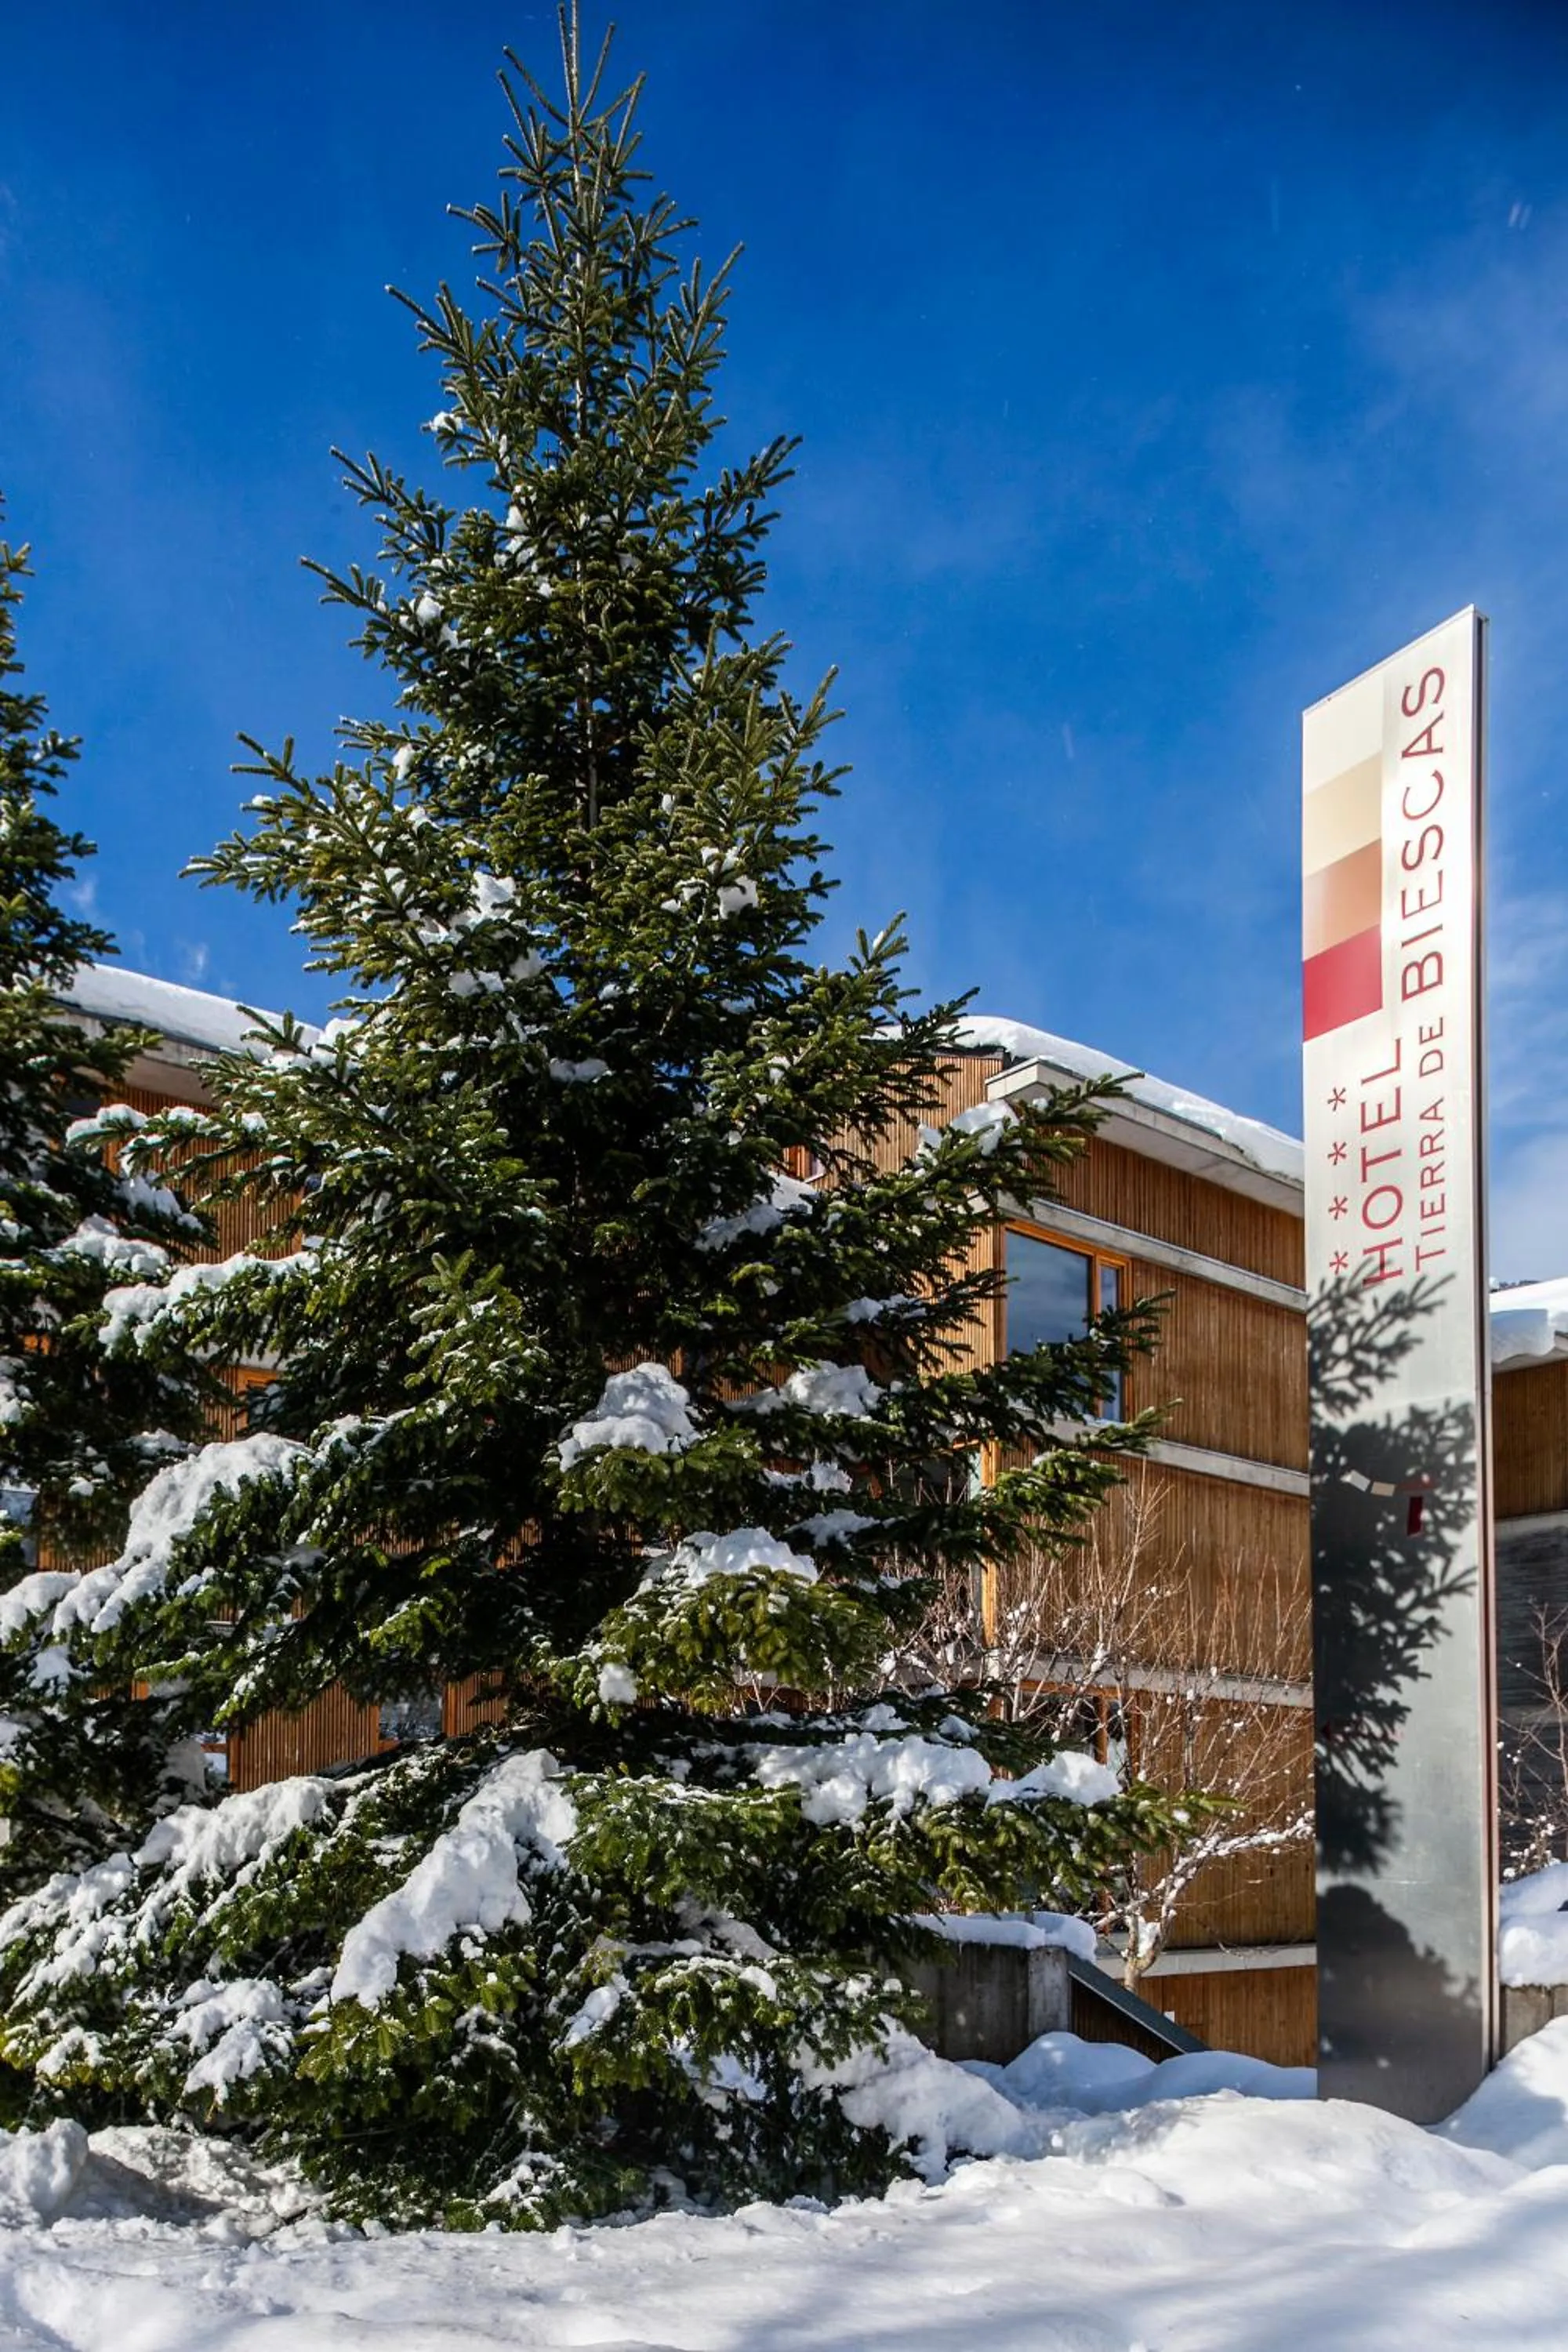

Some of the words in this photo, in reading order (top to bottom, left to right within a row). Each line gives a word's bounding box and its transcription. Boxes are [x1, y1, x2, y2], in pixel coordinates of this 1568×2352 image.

[1401, 666, 1446, 1002] BIESCAS
[1419, 1017, 1444, 1078] DE
[1360, 1037, 1403, 1287] HOTEL
[1415, 1098, 1445, 1272] TIERRA
